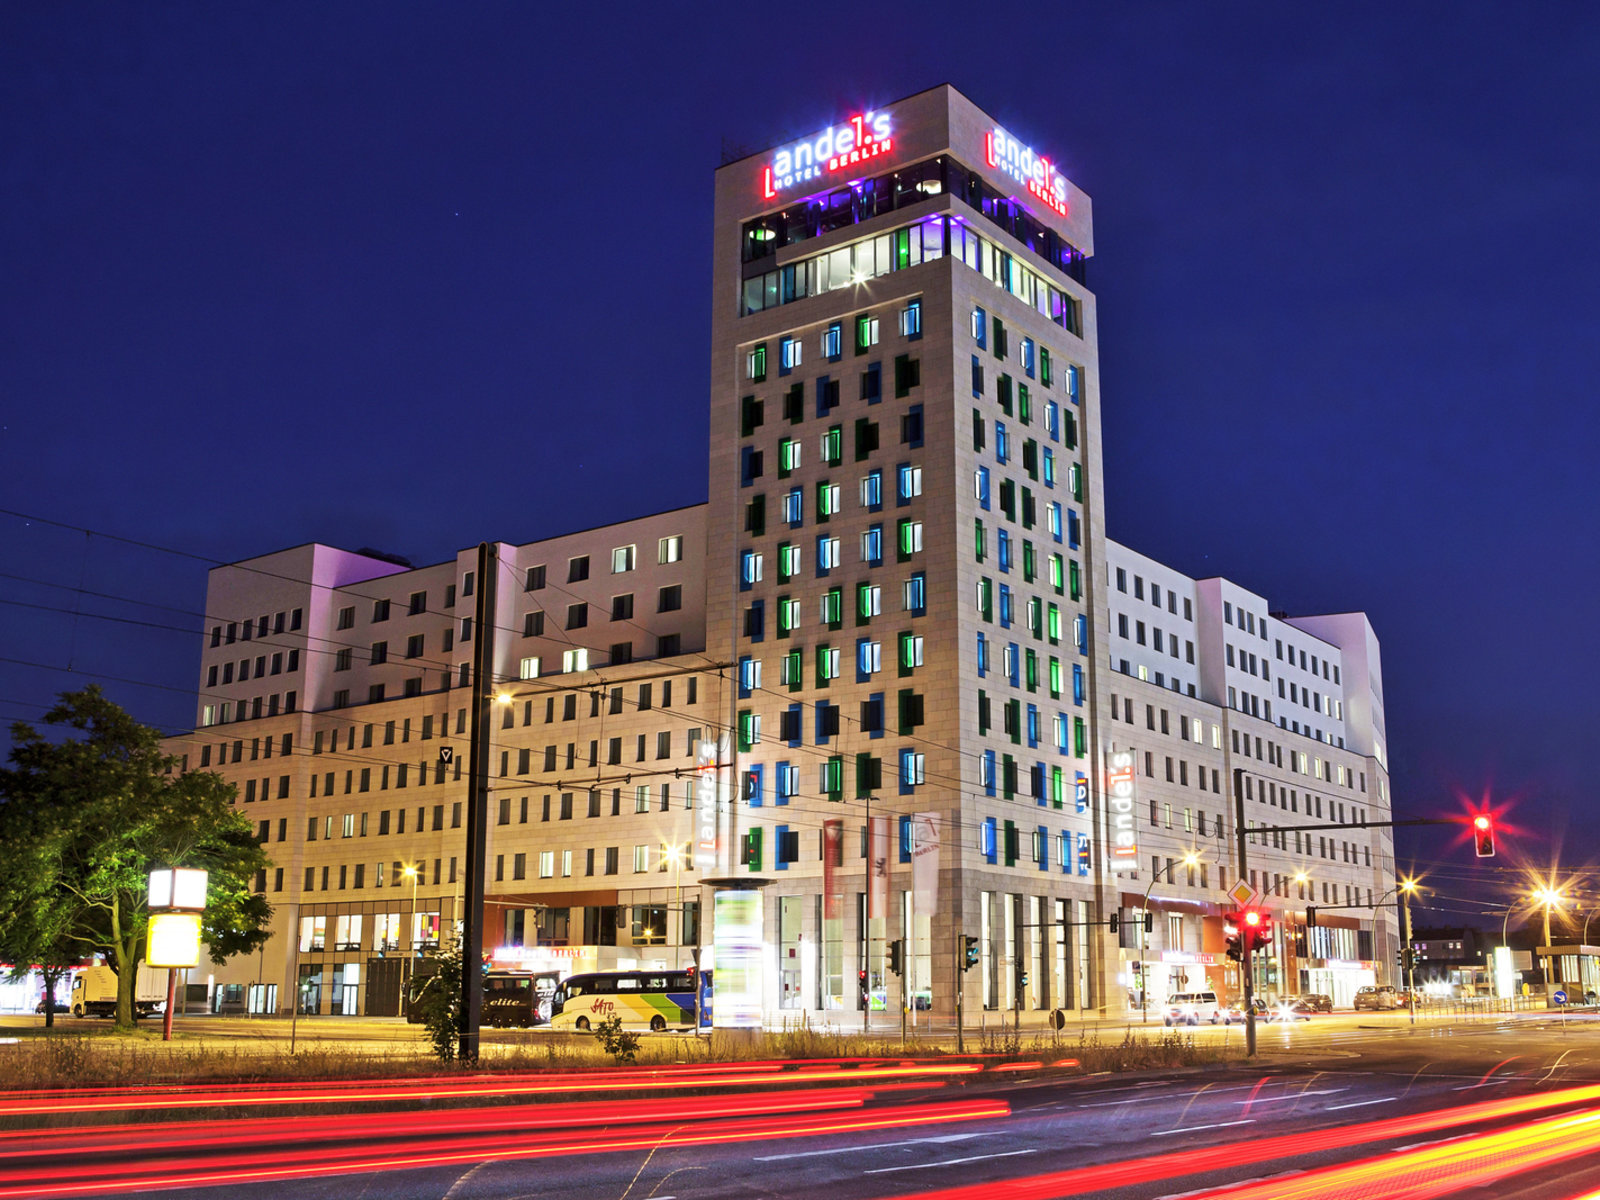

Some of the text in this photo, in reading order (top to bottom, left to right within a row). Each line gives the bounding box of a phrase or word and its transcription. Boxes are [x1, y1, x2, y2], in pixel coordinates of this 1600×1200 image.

[774, 138, 892, 190] HOTEL BERLIN
[994, 154, 1067, 216] HOTEL BERLIN
[489, 998, 520, 1007] elite
